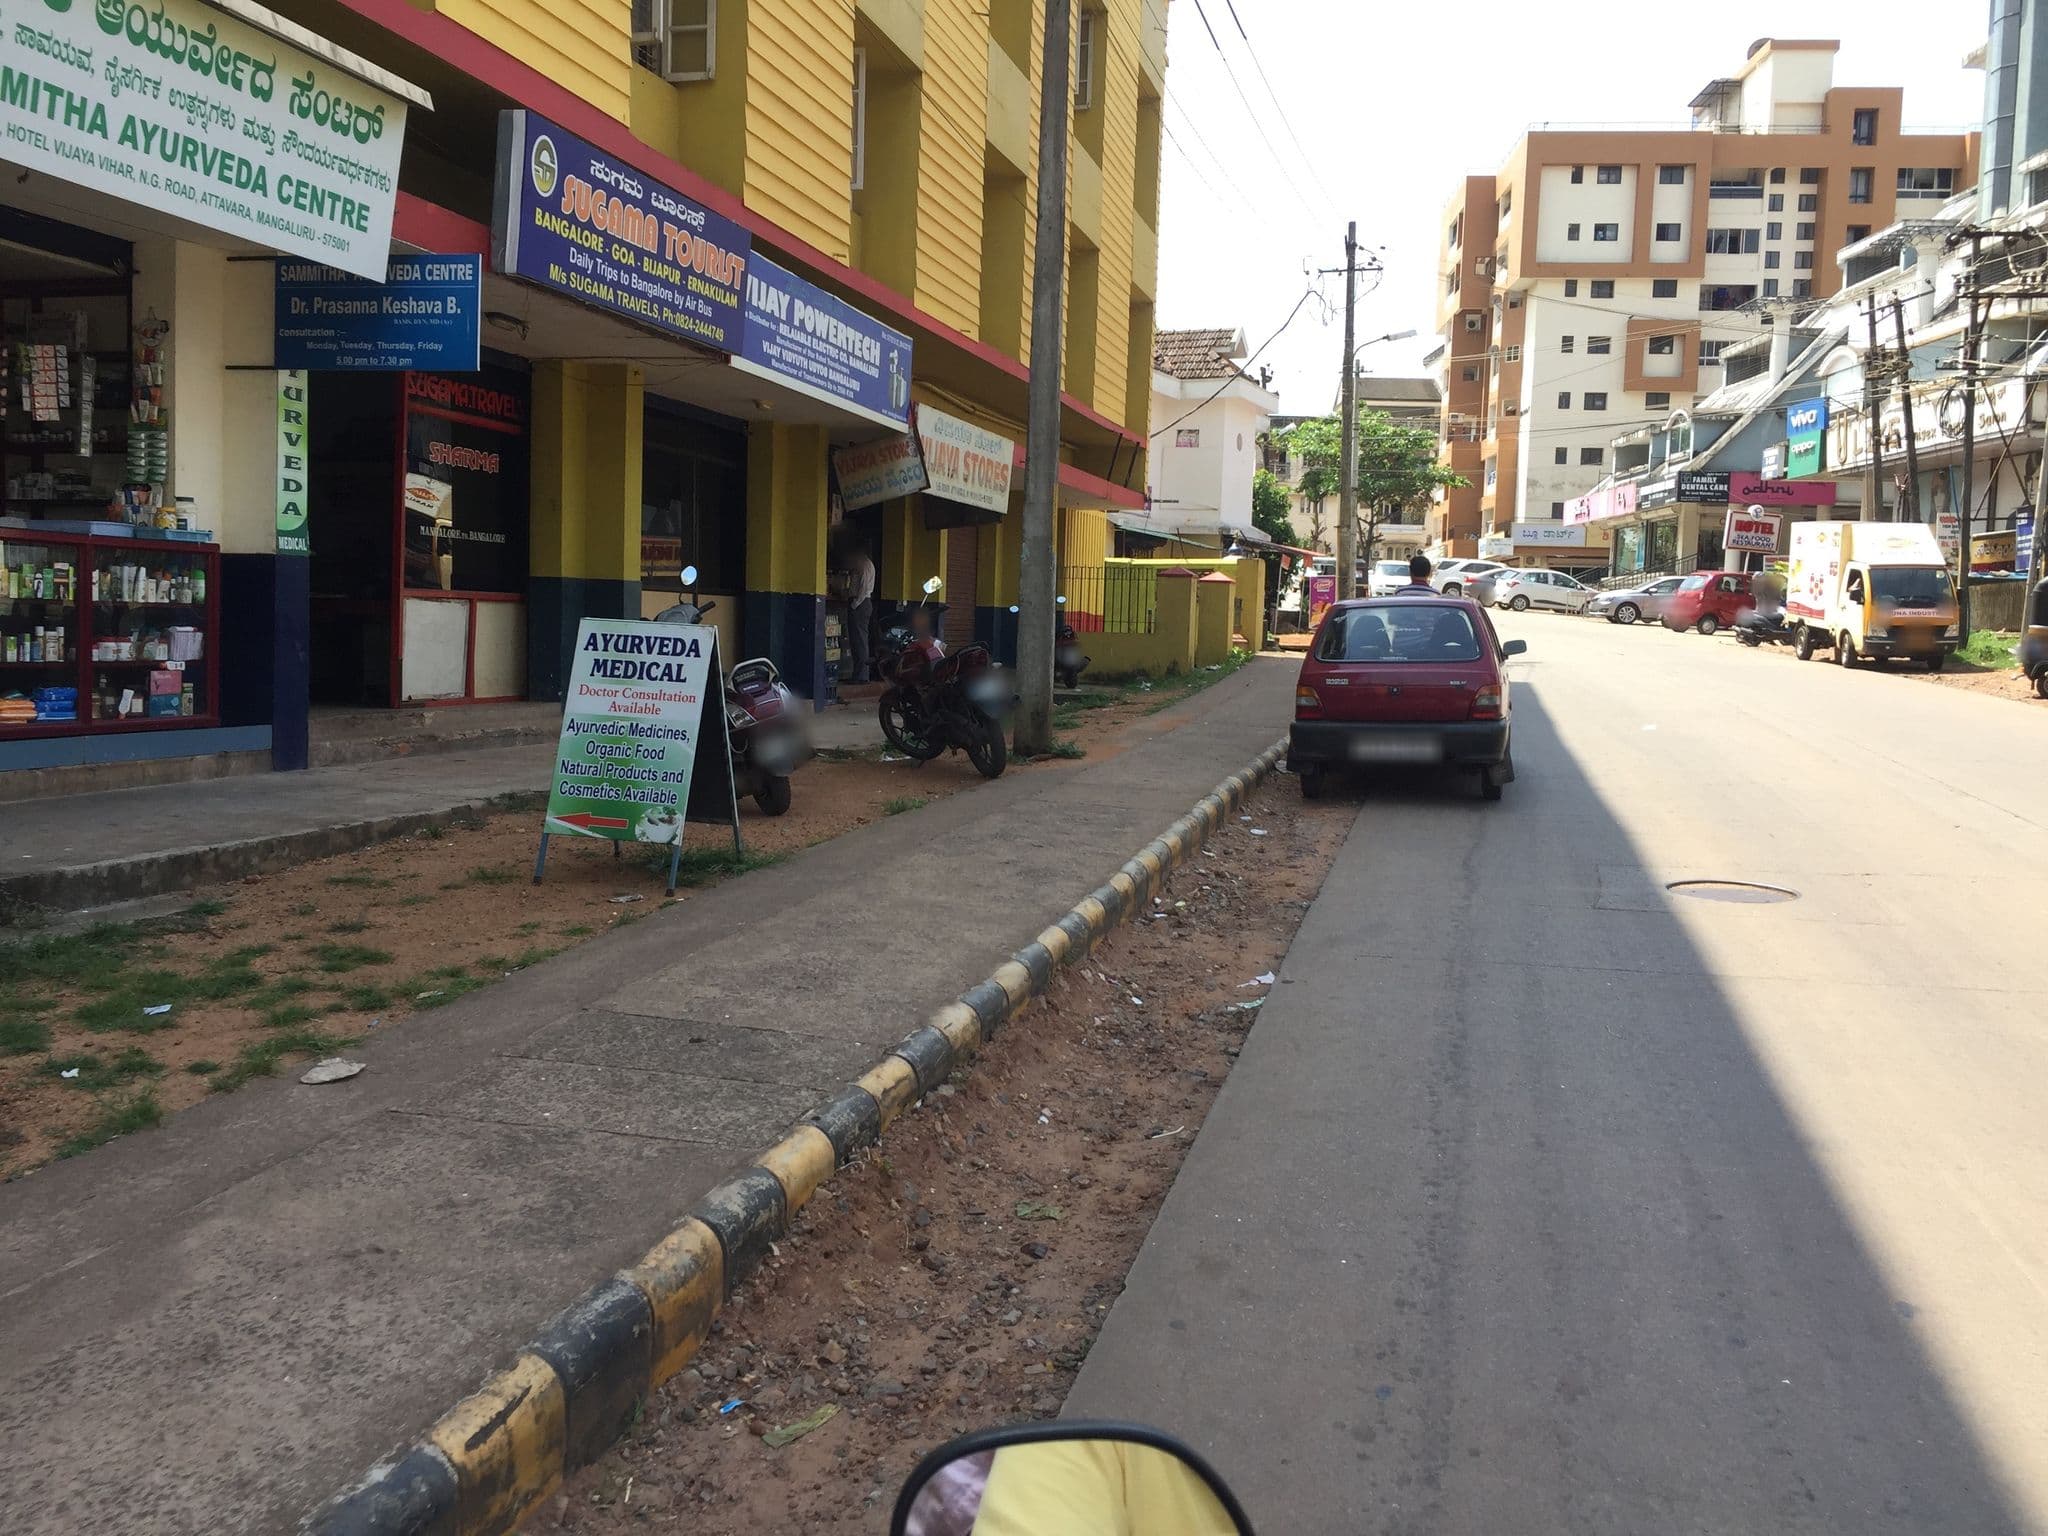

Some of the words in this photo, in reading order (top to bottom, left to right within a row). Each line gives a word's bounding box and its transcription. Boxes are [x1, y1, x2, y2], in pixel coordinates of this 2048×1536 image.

[289, 70, 385, 144] ಸೆಂಟರ್
[242, 116, 275, 156] ಮತ್ತು
[118, 113, 269, 199] AYURVEDA
[277, 173, 371, 233] CENTRE
[590, 159, 643, 199] ಸುಗಮ
[6, 122, 50, 152] HOTEL
[54, 138, 96, 169] VIJAYA
[99, 154, 136, 181] VIHAR,
[139, 169, 161, 191] N.G.
[165, 177, 197, 202] ROAD,
[200, 191, 254, 222] ATTAVARA,
[256, 210, 316, 242] MANGALURU
[322, 233, 351, 253] 575001
[561, 174, 659, 254] SUGAMA
[663, 222, 746, 290] TOURIST
[535, 207, 604, 254] BANGALORE
[612, 245, 635, 268] GOA
[643, 258, 681, 286] BIJAPUR
[687, 275, 738, 309] ERNAKULAM
[425, 263, 473, 281] CENTRE
[569, 247, 594, 274] Daily
[596, 258, 618, 284] Trips
[620, 269, 629, 285] to
[631, 274, 679, 305] Bangalore
[675, 290, 685, 308] by
[685, 295, 697, 310] Air
[698, 301, 712, 317] Bus
[549, 263, 567, 286] M/s
[570, 273, 614, 303] SUGAMA
[617, 289, 661, 321] TRAVELS,
[291, 297, 309, 314] Dr.
[314, 297, 378, 314] Prasanna
[383, 296, 442, 314] Keshava
[447, 296, 461, 314] B.
[279, 328, 335, 337] Consultation
[794, 298, 881, 367] POWERTECH
[306, 341, 338, 351] Monday,
[341, 341, 374, 351] Tuesday,
[377, 341, 416, 351] Thursday,
[418, 341, 443, 351] Friday
[762, 340, 781, 357] VIJAY
[813, 336, 839, 358] ELECTRIC
[354, 358, 369, 366] pm
[370, 356, 379, 365] to
[399, 358, 412, 366] pm
[1790, 409, 1817, 428] vivo
[429, 441, 500, 474] SHARMA
[1791, 440, 1816, 454] oppo
[962, 450, 1009, 495] STORES
[469, 530, 506, 543] BANGALORE
[1734, 519, 1775, 535] HOTEL
[278, 536, 308, 551] MEDICAL
[1732, 539, 1775, 549] RESTAURANT
[583, 632, 702, 658] AYURVEDA
[589, 658, 687, 683] MEDICAL
[579, 684, 619, 698] Doctor
[622, 687, 696, 703] Consultation
[607, 701, 661, 715] Available
[566, 718, 625, 737] Ayurvedic
[628, 722, 690, 743] Medicines,
[586, 740, 632, 761] Organic
[635, 744, 665, 760] Food
[560, 759, 602, 777] Natural
[605, 763, 659, 783] Products
[662, 768, 684, 783] and
[559, 781, 621, 800] Cosmetics
[624, 786, 677, 805] Available
